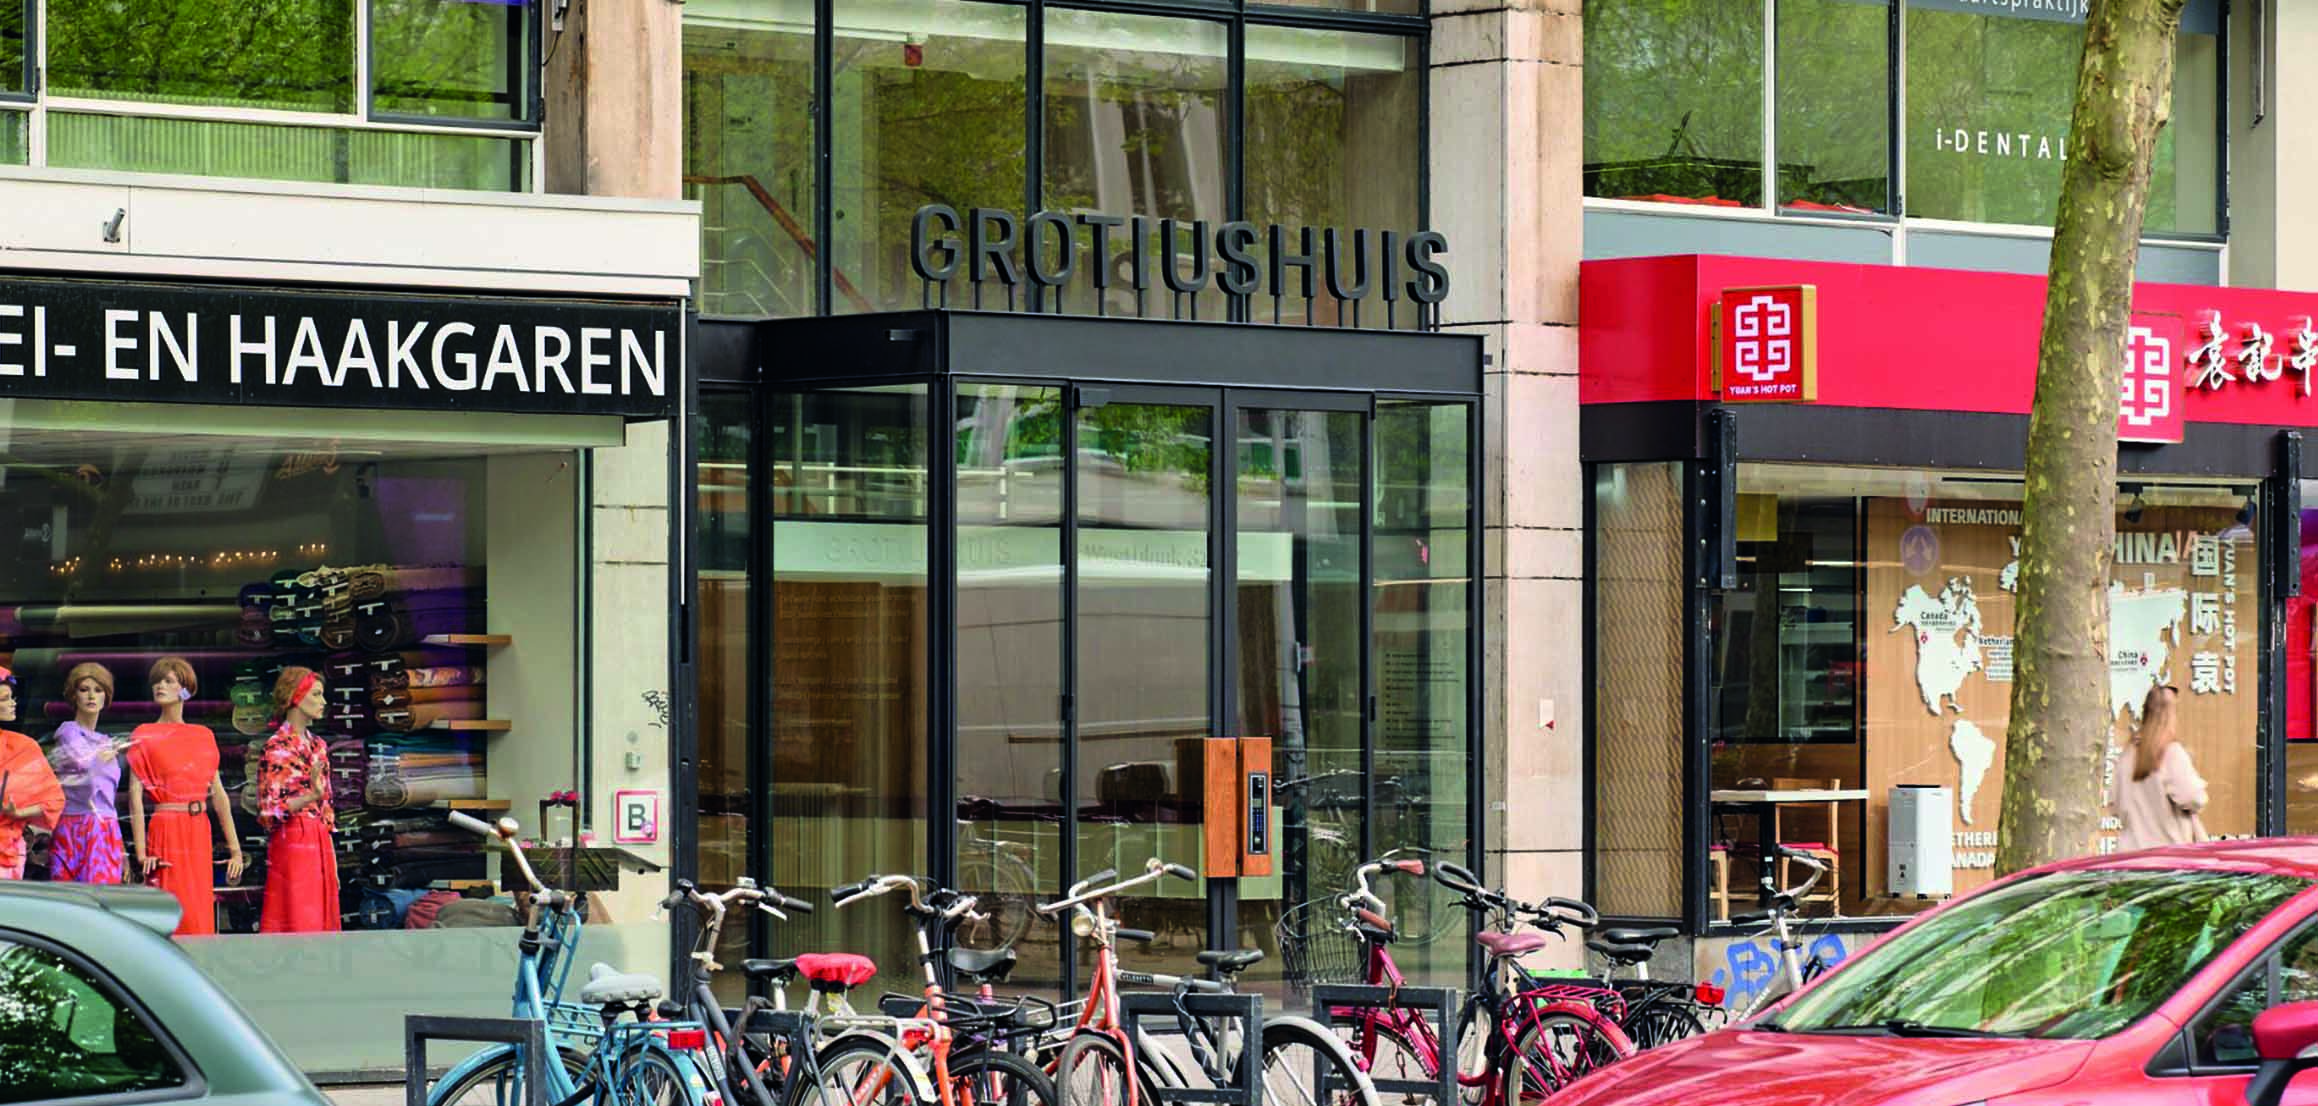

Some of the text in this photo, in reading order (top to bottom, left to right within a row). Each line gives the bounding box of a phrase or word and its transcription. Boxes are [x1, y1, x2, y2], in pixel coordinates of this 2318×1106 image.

[1935, 127, 2068, 162] i-DENTAL
[909, 204, 1450, 304] GROTIUSHUIS
[105, 309, 199, 382] EN
[229, 314, 667, 397] HAAKGAREN
[1761, 384, 1778, 394] HOT
[1780, 383, 1797, 394] POT
[628, 804, 646, 831] B
